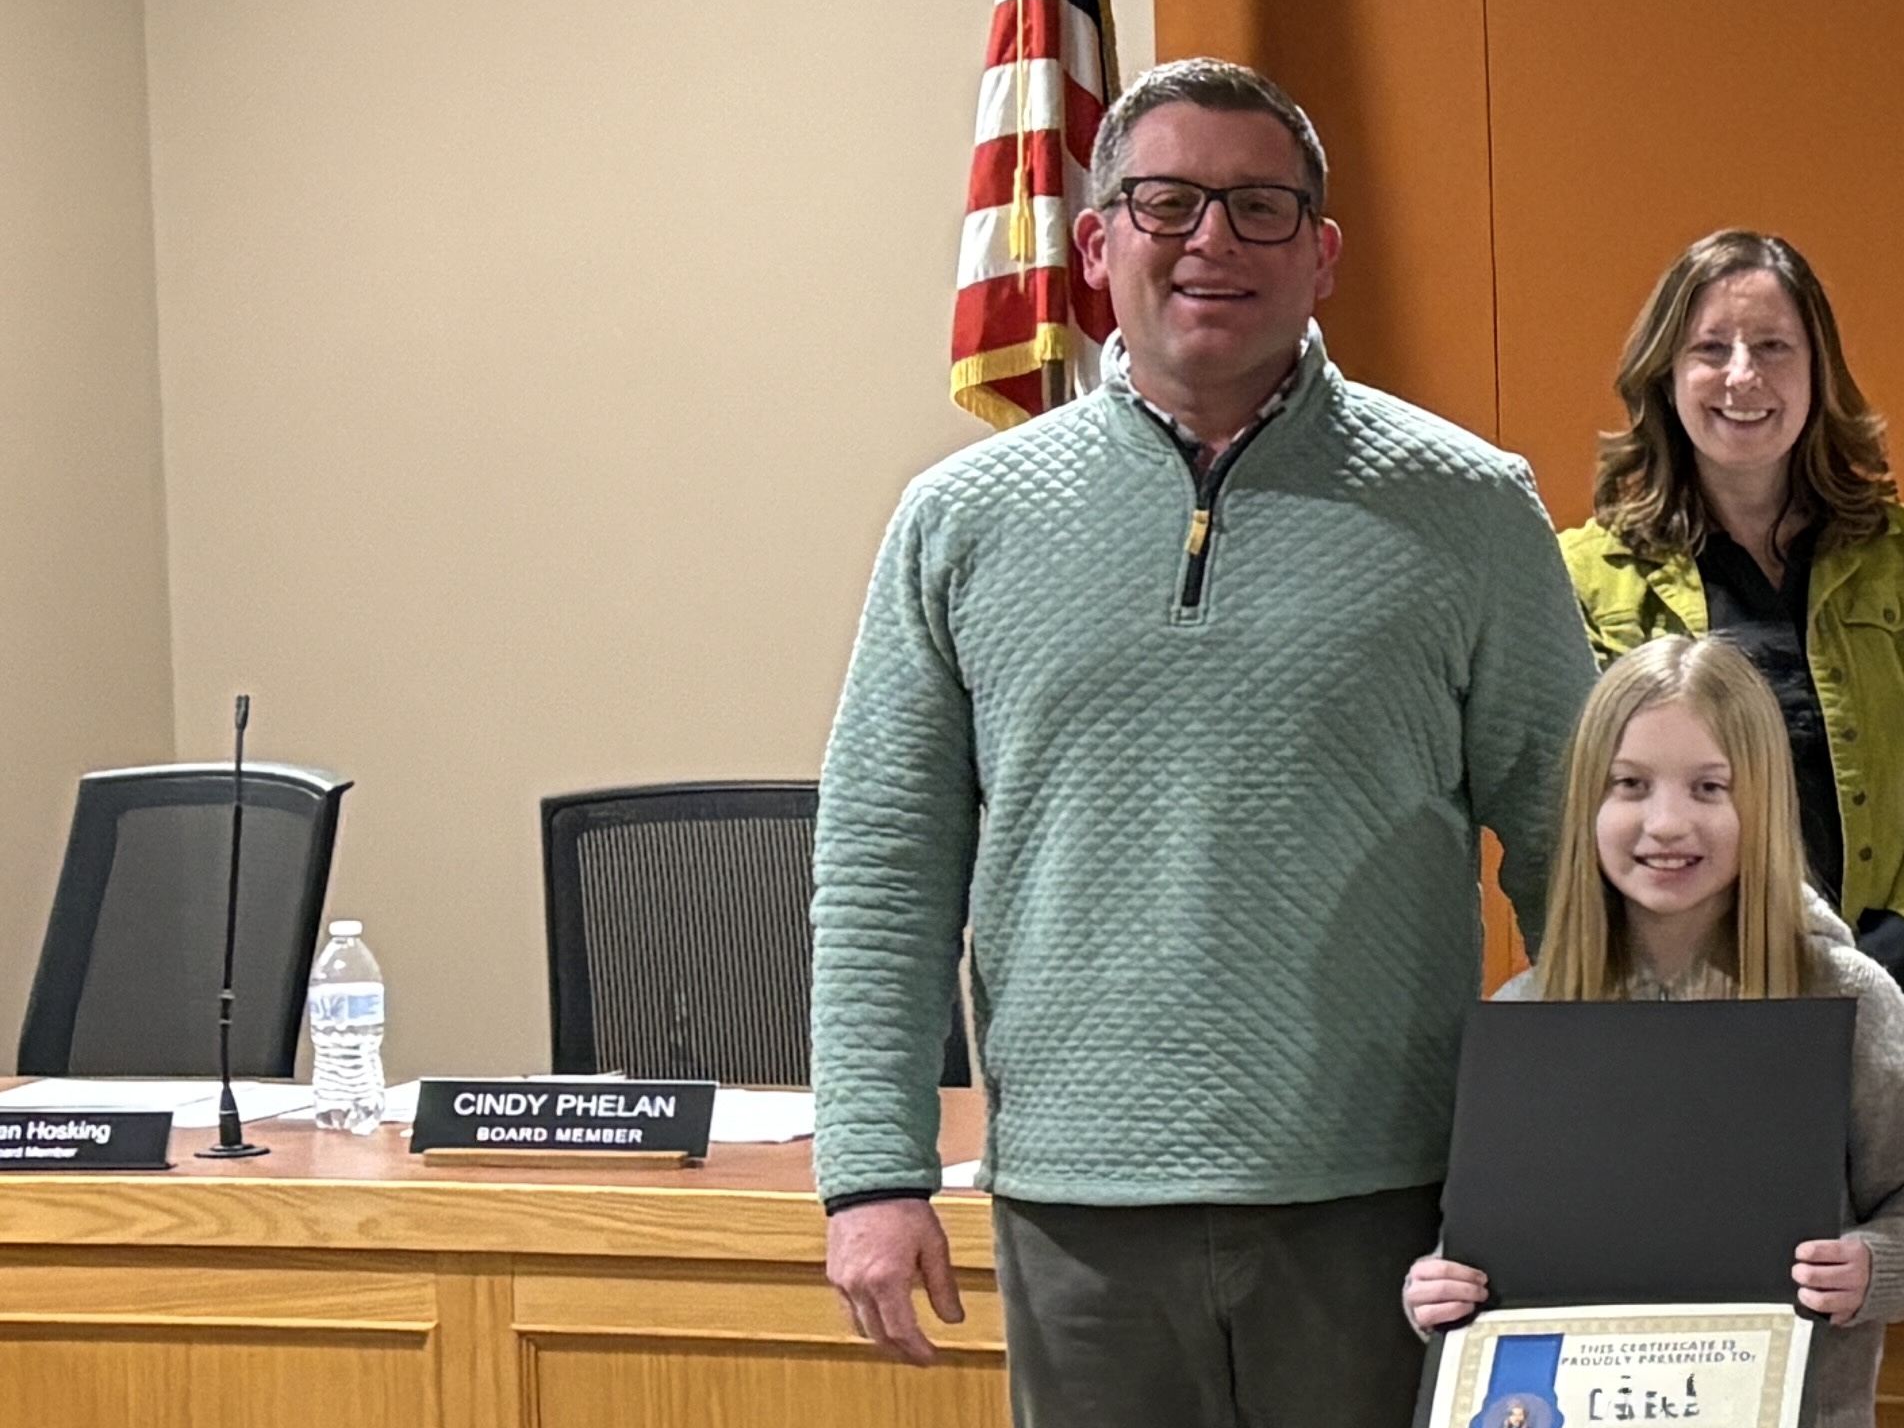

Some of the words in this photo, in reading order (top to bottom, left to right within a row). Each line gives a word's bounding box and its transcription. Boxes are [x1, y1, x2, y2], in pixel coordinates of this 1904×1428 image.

[453, 1091, 550, 1116] CINDY
[555, 1093, 676, 1118] PHELAN
[26, 1120, 112, 1144] Hosking
[476, 1125, 548, 1143] BOARD
[554, 1126, 644, 1144] MEMBER
